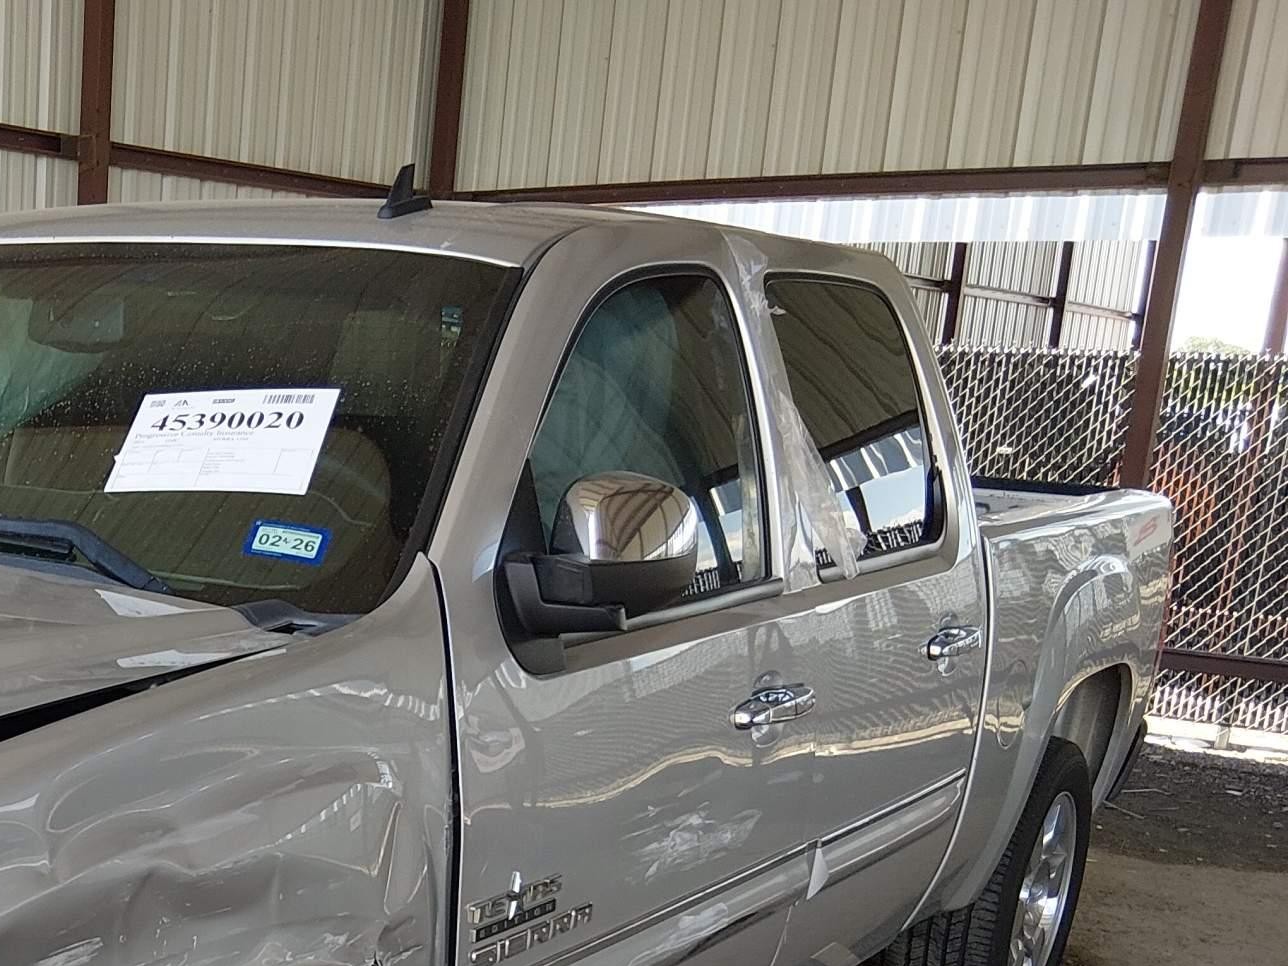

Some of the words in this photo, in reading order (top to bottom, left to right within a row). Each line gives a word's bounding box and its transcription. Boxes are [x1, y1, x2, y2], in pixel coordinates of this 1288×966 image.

[150, 410, 306, 431] 45390020
[258, 533, 282, 547] 02
[291, 538, 316, 553] 26
